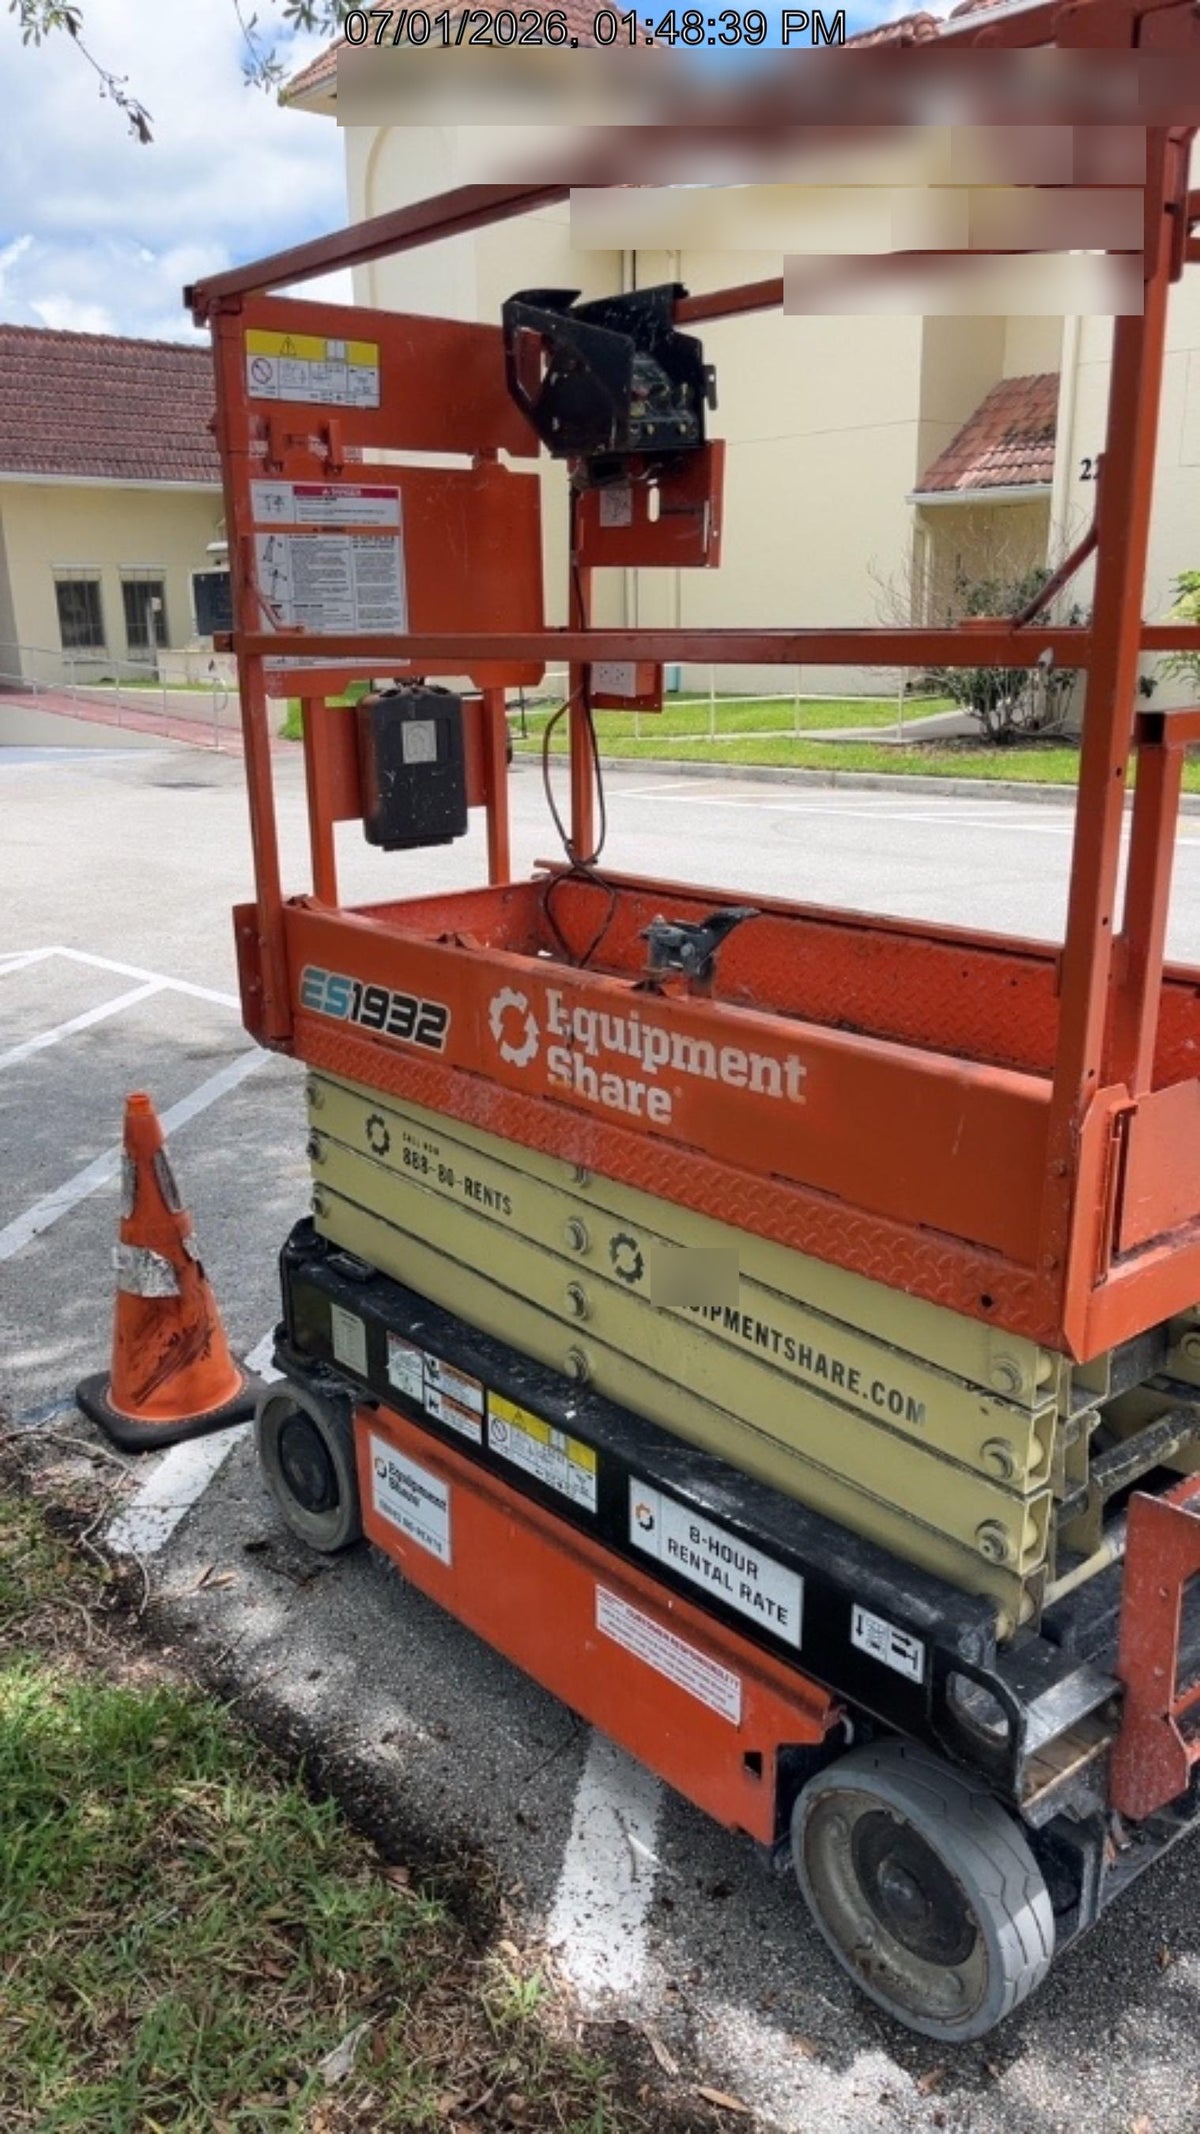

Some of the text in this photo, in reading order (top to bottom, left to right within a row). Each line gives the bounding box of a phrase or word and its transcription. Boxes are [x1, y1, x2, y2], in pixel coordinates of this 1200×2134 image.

[1079, 458, 1099, 482] 2
[300, 966, 449, 1051] ES1932
[546, 988, 807, 1104] Equipment
[402, 1146, 513, 1216] 888-80-RENTS
[668, 1537, 788, 1626] RENTAL RATE
[689, 1525, 758, 1580] 8-HOUR
